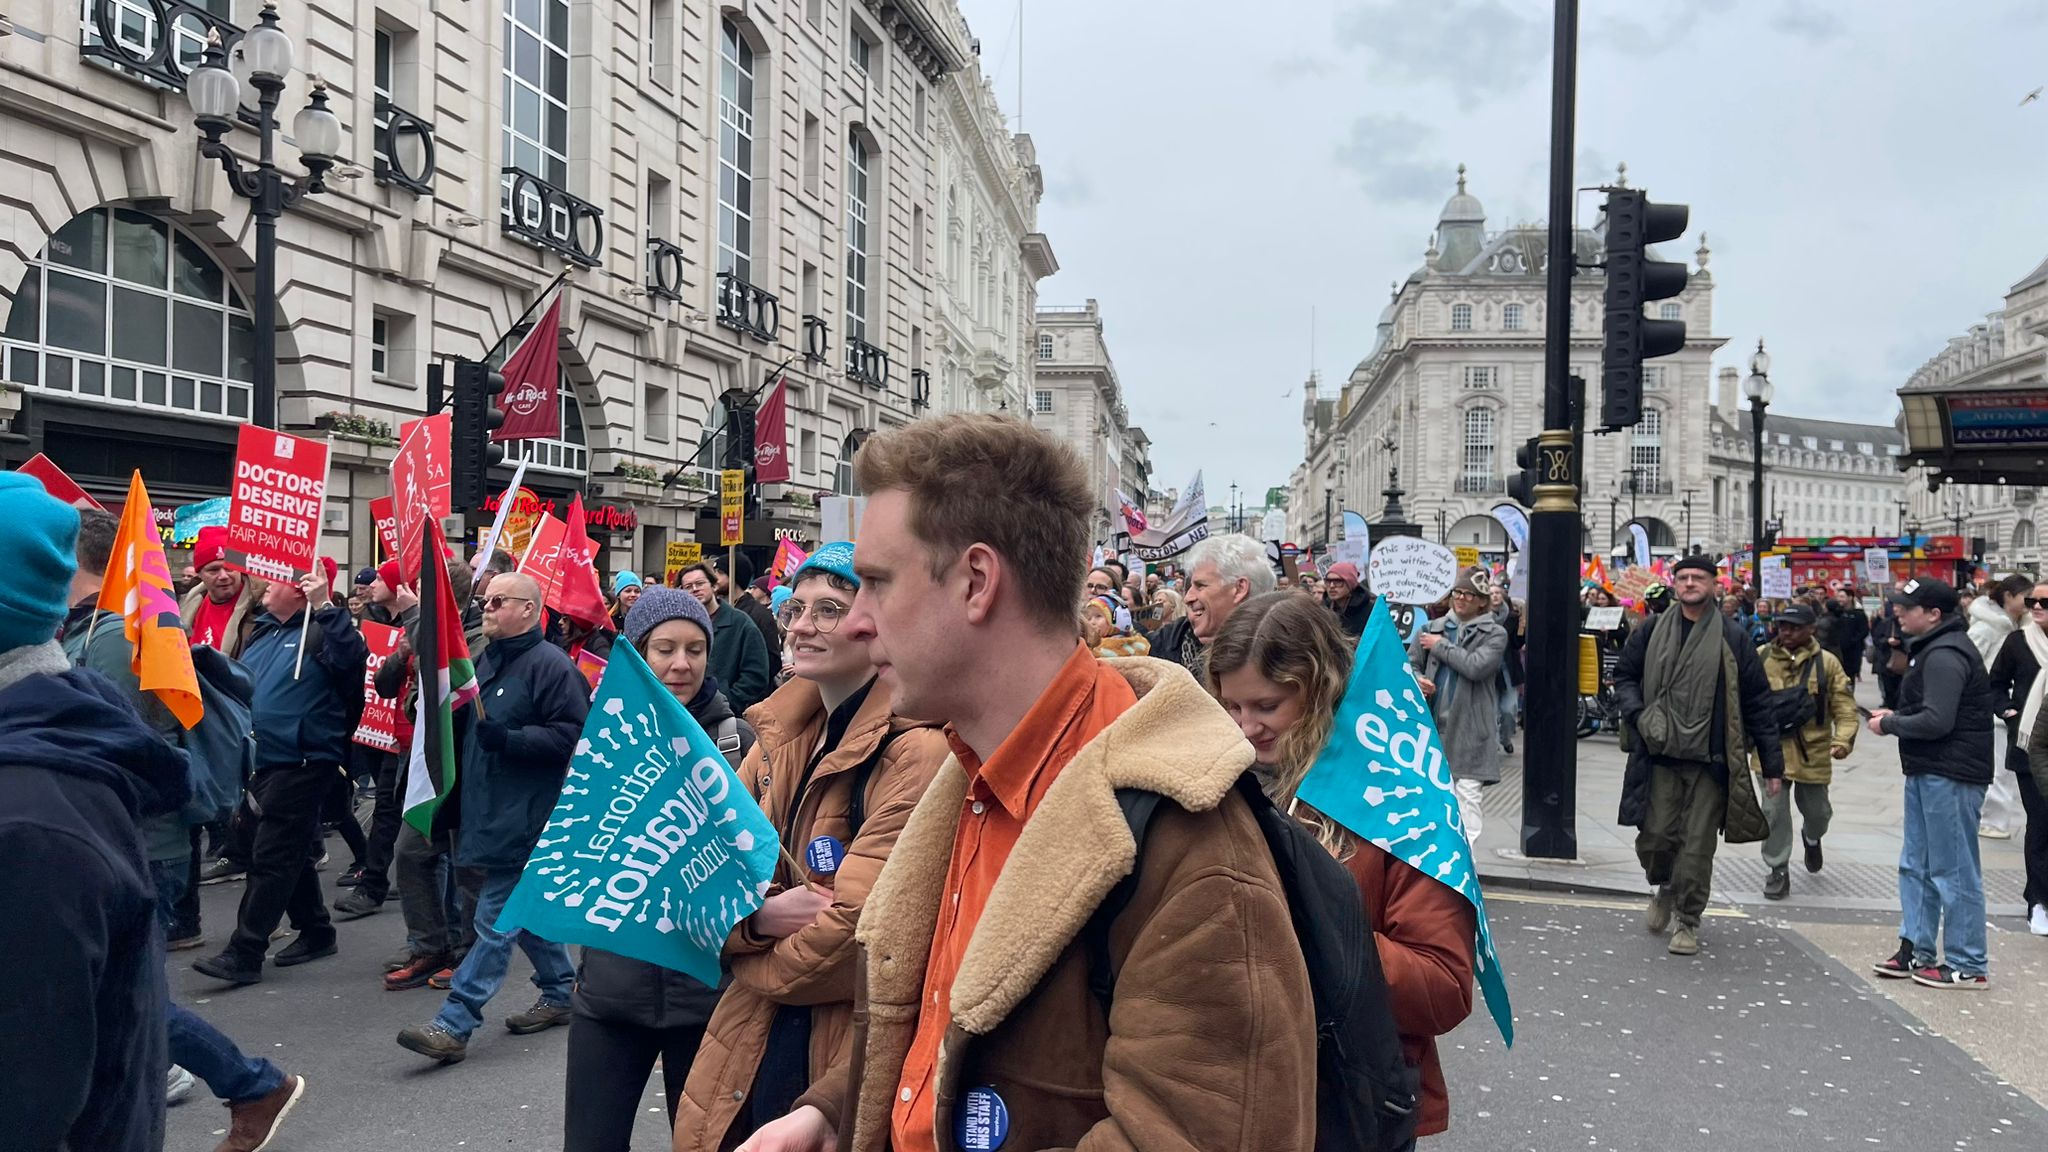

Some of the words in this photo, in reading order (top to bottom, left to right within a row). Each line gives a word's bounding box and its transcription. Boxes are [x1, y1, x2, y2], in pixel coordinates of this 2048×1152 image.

[525, 388, 547, 402] Rock
[1972, 411, 2039, 421] MONEY
[237, 460, 324, 498] DOCTORS
[238, 482, 319, 519] DESERVE
[519, 496, 556, 517] Rock
[153, 507, 173, 522] Rock
[240, 505, 309, 538] BETTER
[230, 523, 257, 543] FAIR
[258, 531, 282, 550] PAY
[283, 539, 315, 559] NOW
[1377, 544, 1398, 556] This
[1405, 542, 1426, 552] sign
[1377, 581, 1390, 590] my
[1396, 578, 1437, 597] education
[367, 706, 387, 721] PAY
[967, 1092, 979, 1114] WITH
[978, 1093, 991, 1125] STAFF
[966, 1116, 978, 1144] STAND
[977, 1127, 990, 1150] NHS
